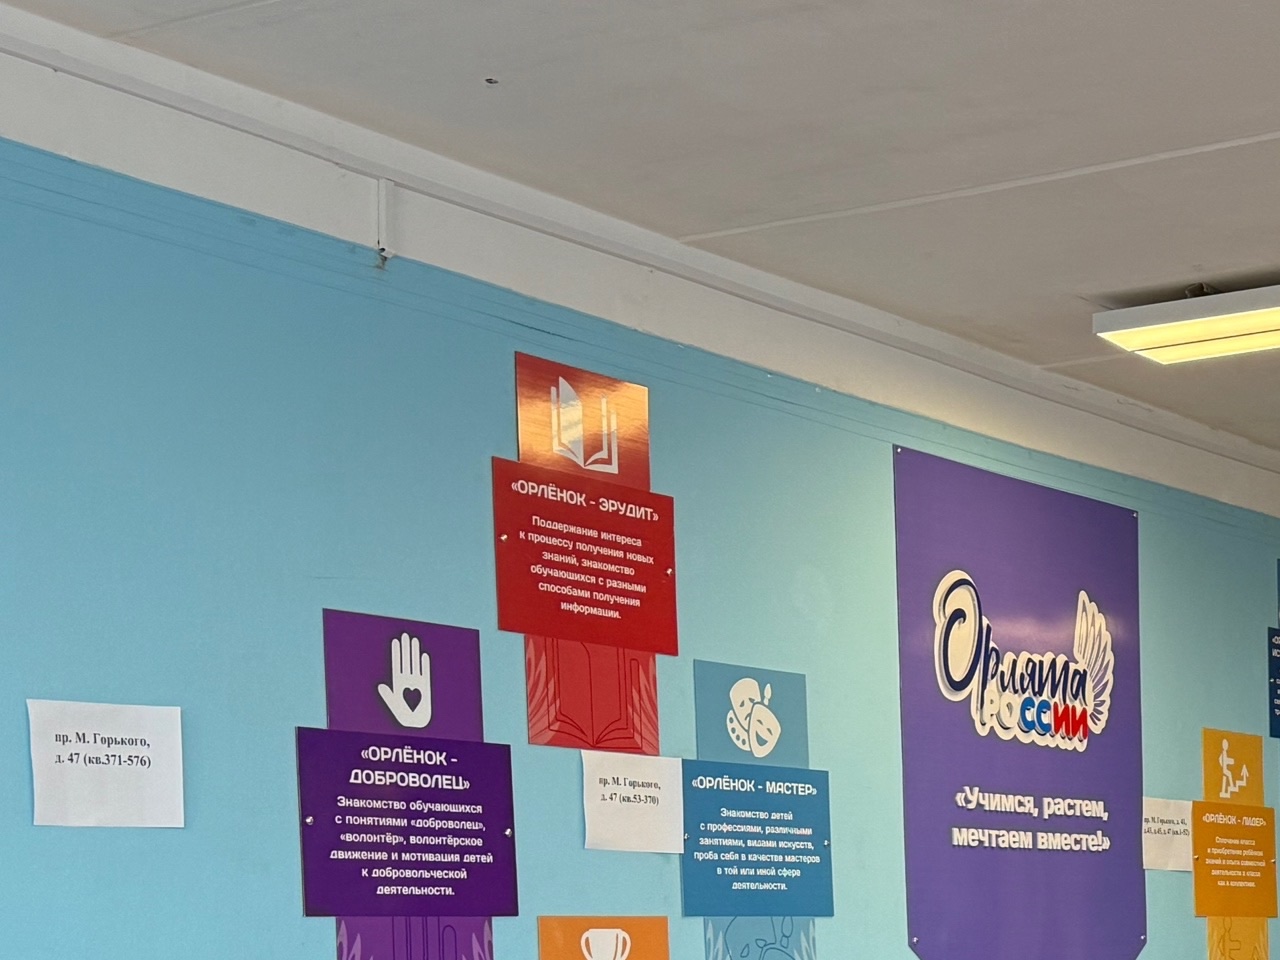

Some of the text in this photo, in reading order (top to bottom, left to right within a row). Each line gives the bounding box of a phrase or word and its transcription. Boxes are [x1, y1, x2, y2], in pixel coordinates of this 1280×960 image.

[511, 479, 587, 507] «ОРЛЁНОК
[599, 498, 658, 521] ЭРУДИТ»
[532, 516, 642, 547] Поддержание интереса
[520, 531, 654, 564] к процессу получения новых
[542, 551, 634, 576] знаний, знакомство
[530, 564, 646, 593] обучающихся с разными
[538, 582, 640, 607] способами получения
[560, 602, 621, 619] информации.
[943, 579, 1089, 726] Орлята
[55, 732, 150, 748] пр. М. Горького,
[55, 753, 151, 768] д. 47 (кв.371-576)
[361, 746, 447, 766] «ОРЛЁНОК
[350, 769, 470, 789] ДОБРОВОЛЕЦ»
[599, 777, 661, 789] пр. М. Горького,
[692, 775, 755, 791] «ОРЛЁНОК
[766, 781, 817, 795] МАСТЕР»
[337, 796, 482, 814] Знакомство обучающихся
[609, 793, 617, 801] 47
[955, 786, 1108, 821] «Учимся, растем,
[721, 808, 792, 820] Знакомство детей
[335, 816, 486, 831] с понятиями «доброволец»,
[340, 833, 483, 847] «волонтёр», волонтёрское
[952, 827, 1110, 851] мечтаем вместе!»
[330, 850, 493, 863] движение и мотивация детей
[694, 852, 718, 861] проба
[721, 852, 738, 860] себя
[371, 868, 467, 879] добровольческой
[724, 866, 738, 875] той
[376, 886, 454, 895] деятельности.
